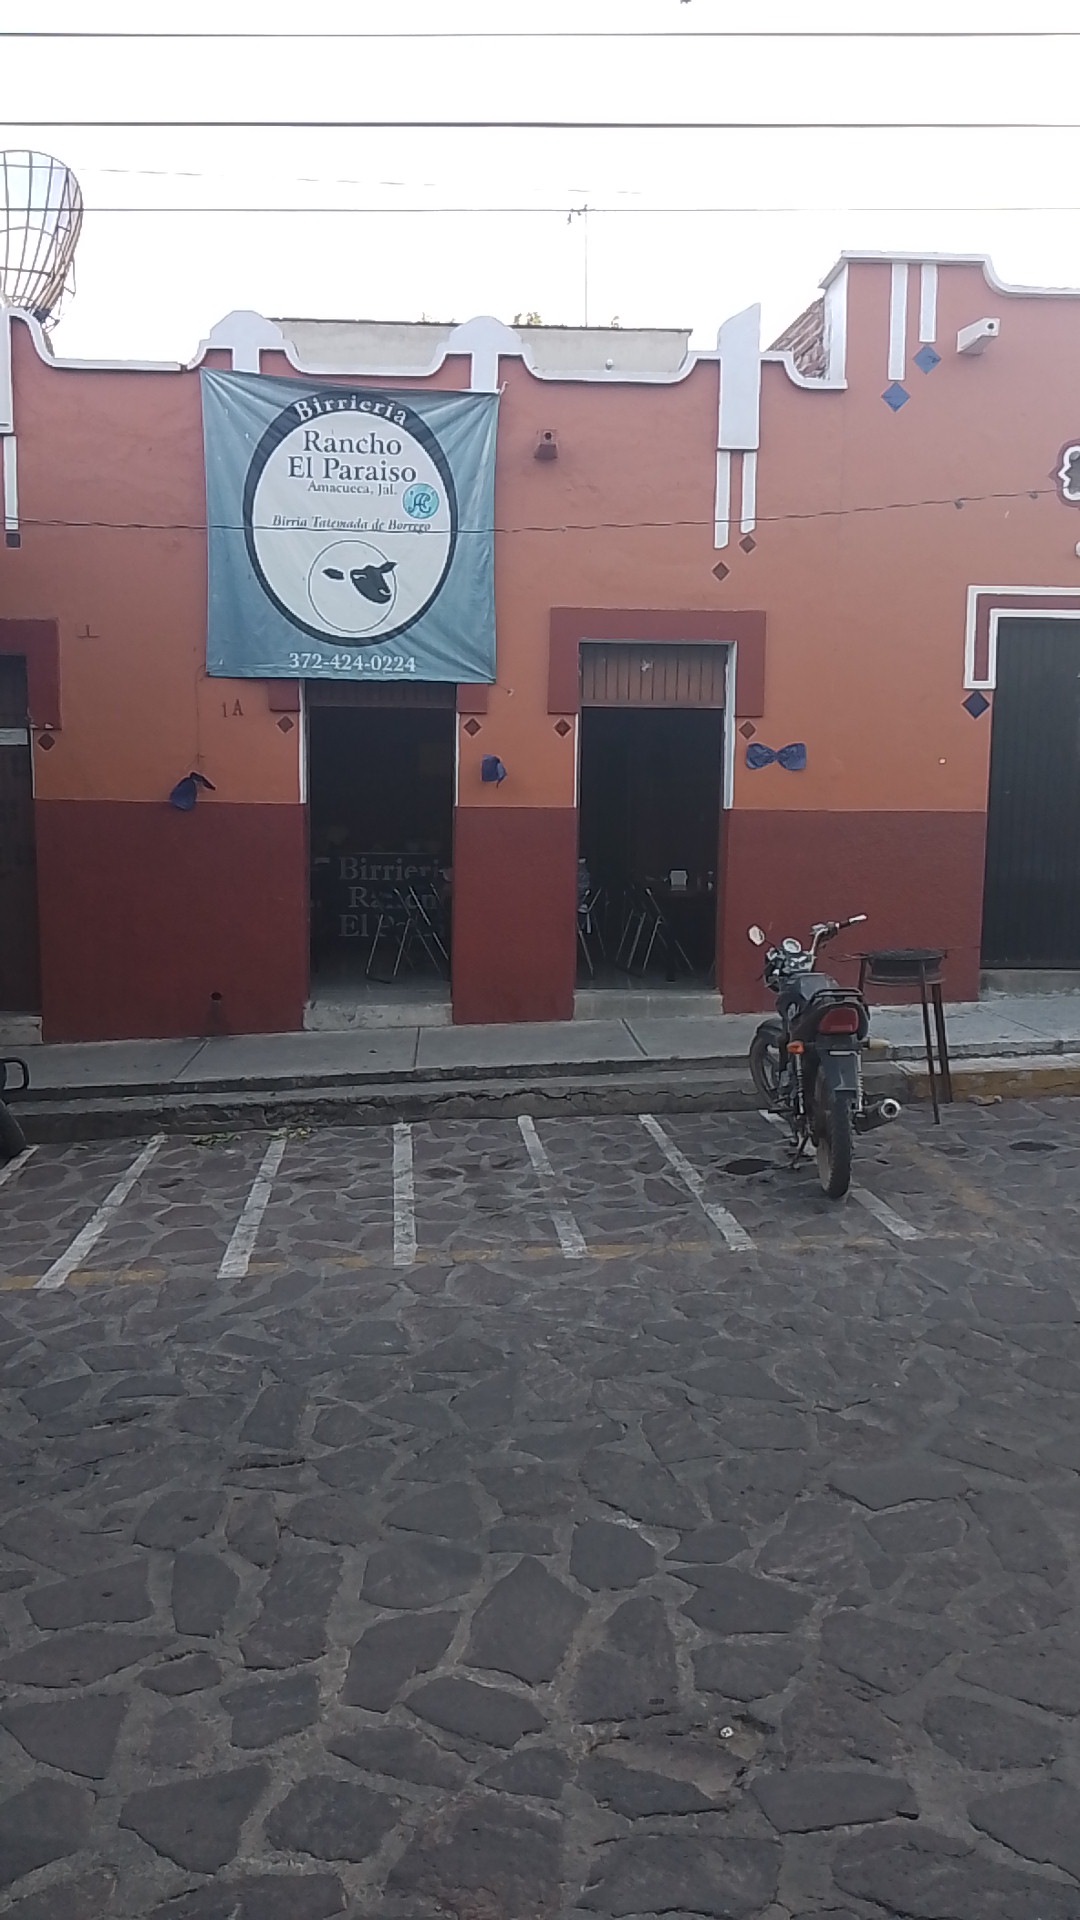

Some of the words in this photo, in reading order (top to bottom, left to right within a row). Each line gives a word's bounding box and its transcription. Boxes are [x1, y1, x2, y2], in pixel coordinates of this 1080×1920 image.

[293, 394, 407, 425] Birrieria
[303, 430, 402, 453] Rancho
[288, 456, 312, 479] El
[322, 458, 417, 482] Paraiso
[377, 483, 398, 496] Jal.
[371, 518, 385, 531] de
[288, 653, 417, 673] 372-424-0224
[339, 857, 452, 881] Birrieri
